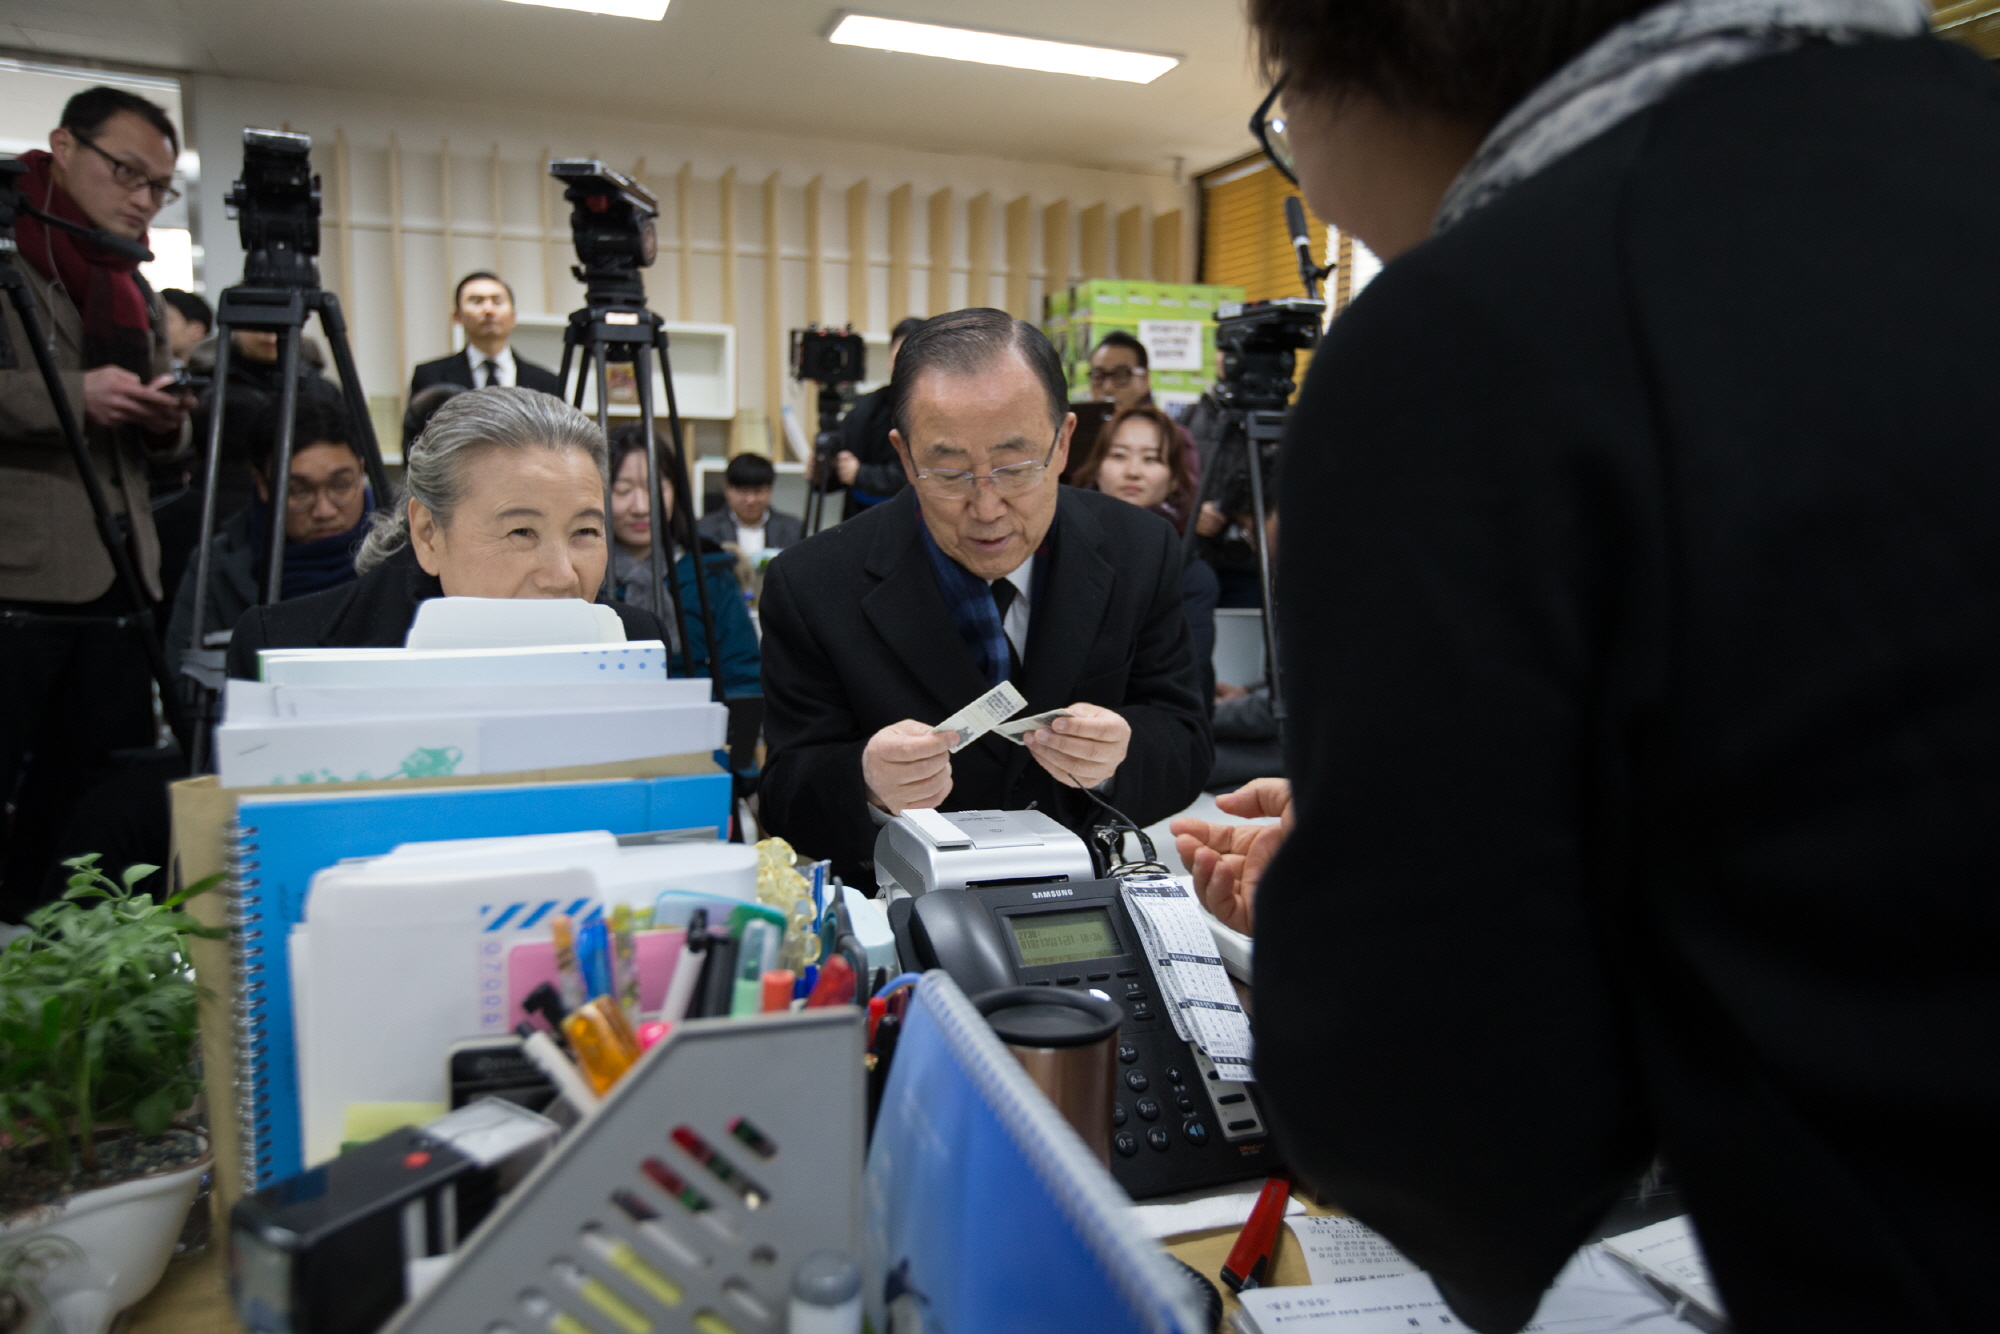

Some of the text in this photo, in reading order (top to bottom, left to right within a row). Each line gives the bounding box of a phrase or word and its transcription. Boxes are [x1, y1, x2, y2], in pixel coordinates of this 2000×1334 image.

[1031, 888, 1074, 899] SAMSUNG
[1119, 1047, 1127, 1056] 3
[1130, 1074, 1138, 1085] 6
[1140, 1103, 1148, 1114] 9
